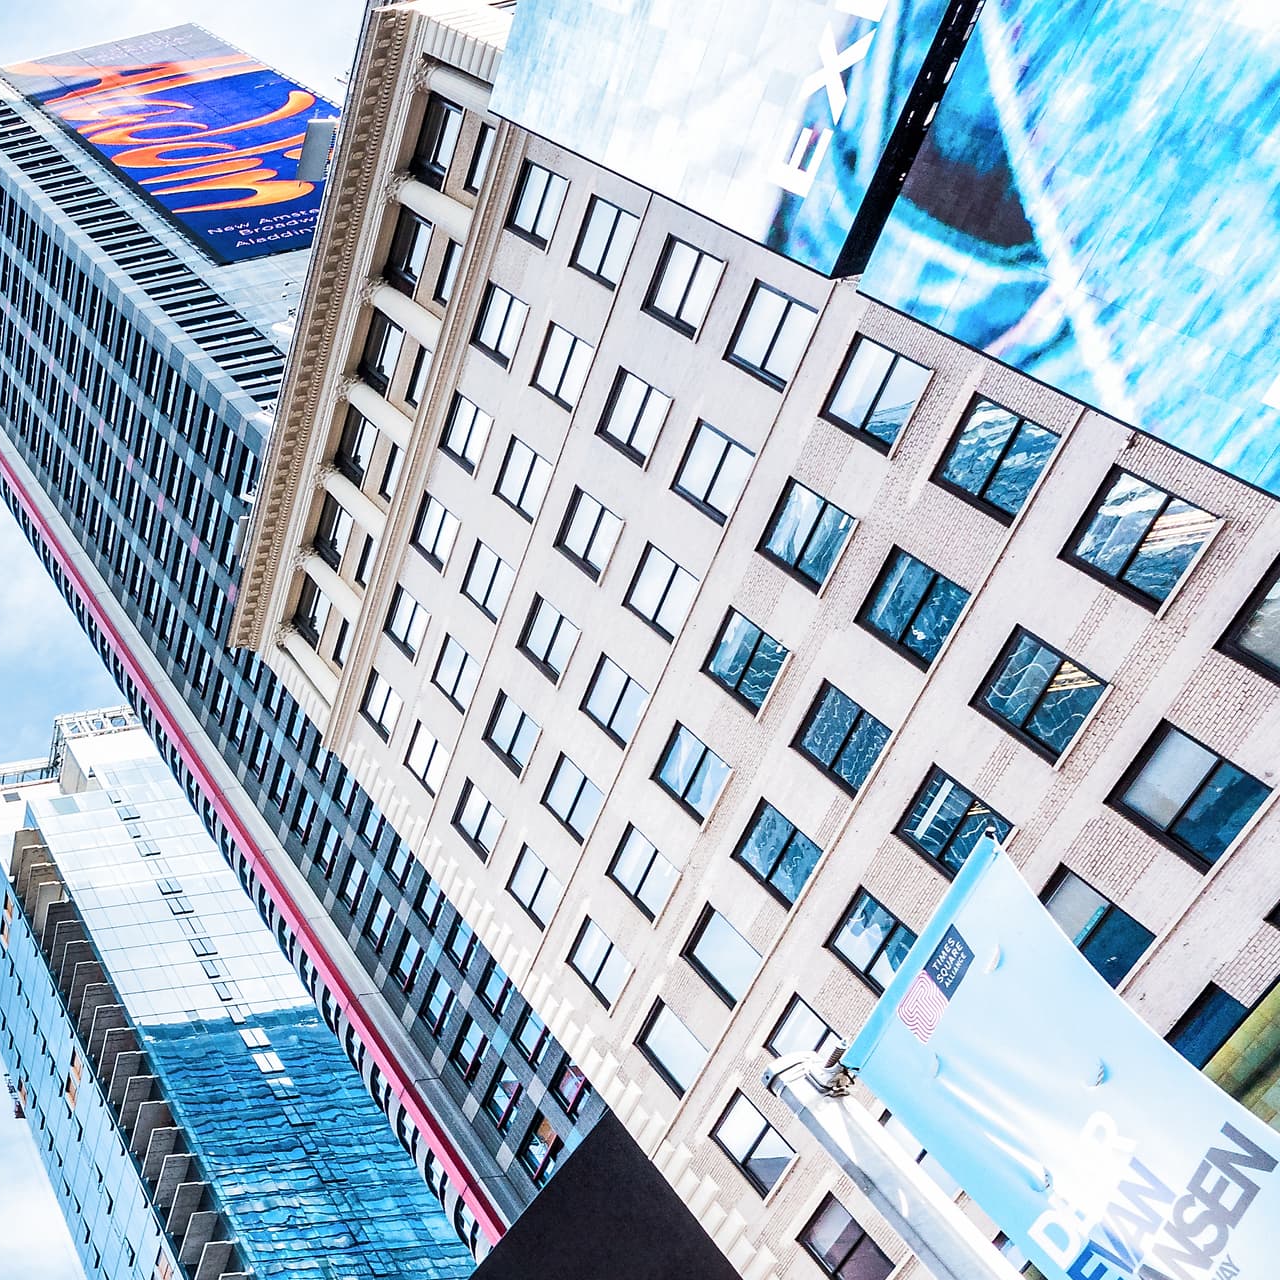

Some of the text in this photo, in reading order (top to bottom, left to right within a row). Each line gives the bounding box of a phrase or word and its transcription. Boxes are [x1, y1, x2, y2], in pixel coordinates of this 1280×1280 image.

[932, 937, 955, 971] TIMES
[936, 941, 964, 983] SQUARE
[944, 955, 967, 988] ALLIANCE
